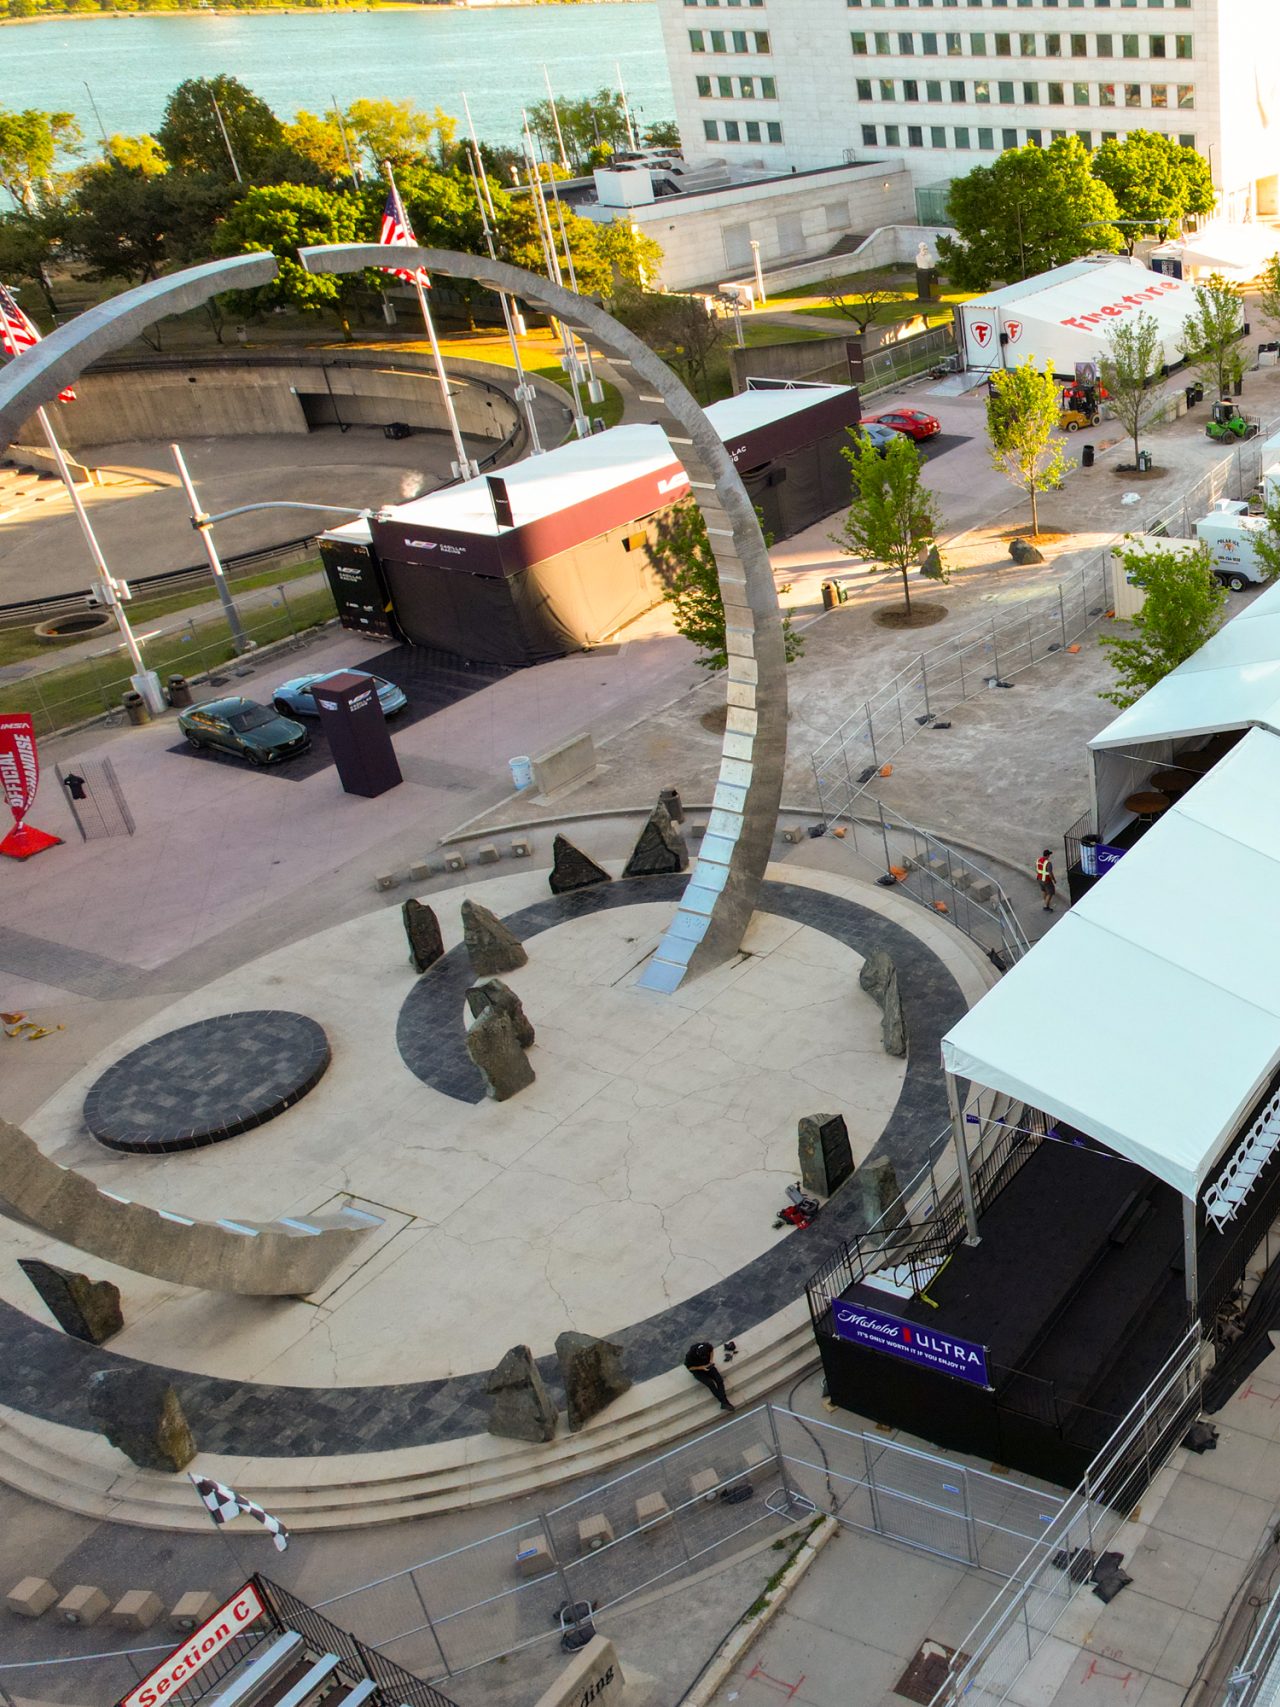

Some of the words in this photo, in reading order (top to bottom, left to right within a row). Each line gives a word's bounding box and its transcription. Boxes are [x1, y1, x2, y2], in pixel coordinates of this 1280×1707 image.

[1059, 281, 1180, 332] Firestone
[0, 751, 24, 808] OFFICIAL
[838, 1309, 899, 1337] Michelob
[915, 1332, 983, 1366] ULTRA
[857, 1330, 869, 1339] IT'S
[869, 1334, 886, 1344] ONLY
[886, 1340, 910, 1353] WORTH
[910, 1347, 917, 1355] IT
[924, 1352, 938, 1362] YOU
[938, 1357, 959, 1369] ENJOY
[138, 1623, 231, 1707] Section
[232, 1600, 250, 1622] C
